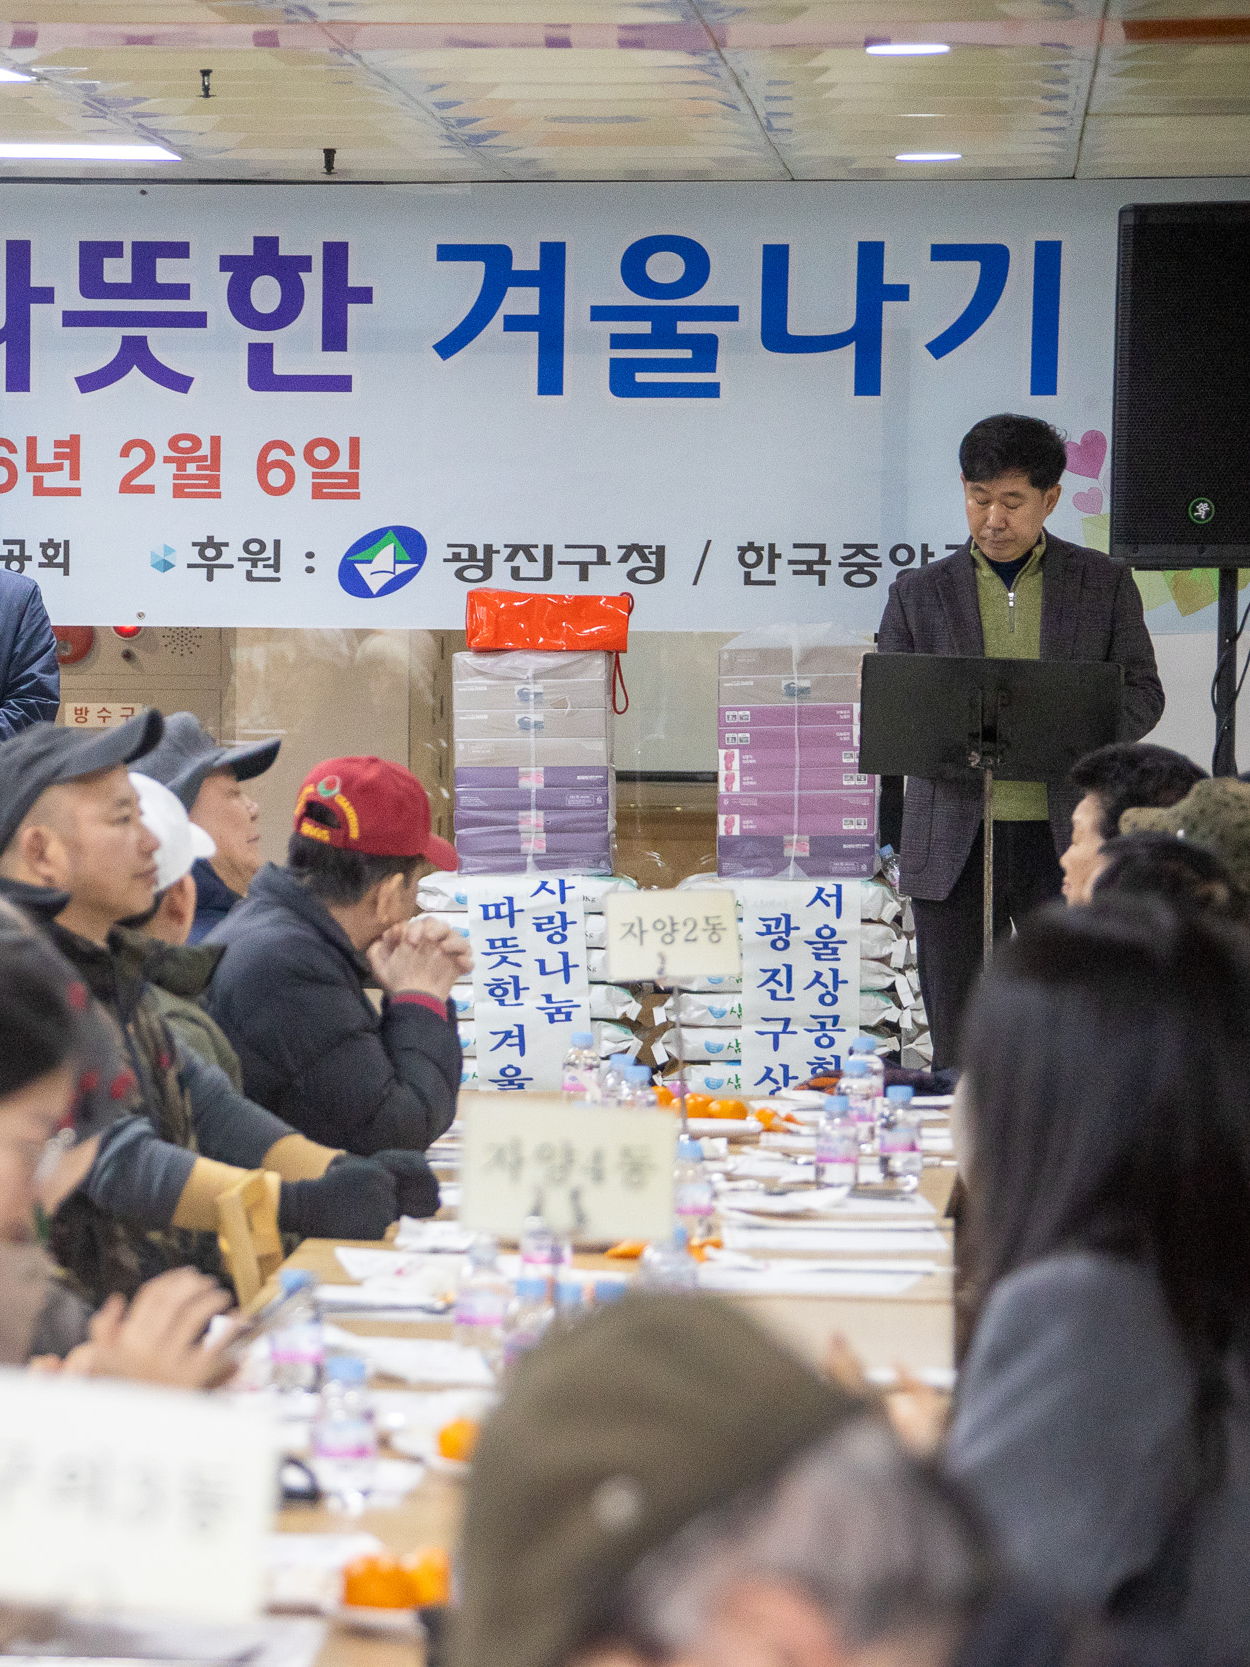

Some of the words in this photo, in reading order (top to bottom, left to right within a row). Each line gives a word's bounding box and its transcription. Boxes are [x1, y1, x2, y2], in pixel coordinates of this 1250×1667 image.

[432, 234, 1063, 398] 겨울나기
[118, 433, 223, 499] 2월
[256, 436, 362, 500] 6일
[187, 534, 282, 583] 후원
[442, 540, 668, 586] 광진구청
[737, 539, 966, 588] 한국중앙
[74, 706, 135, 724] 방수구
[478, 896, 530, 1007] 따뜻한
[530, 878, 581, 1025] 사랑나눔
[619, 914, 728, 946] 자양2동
